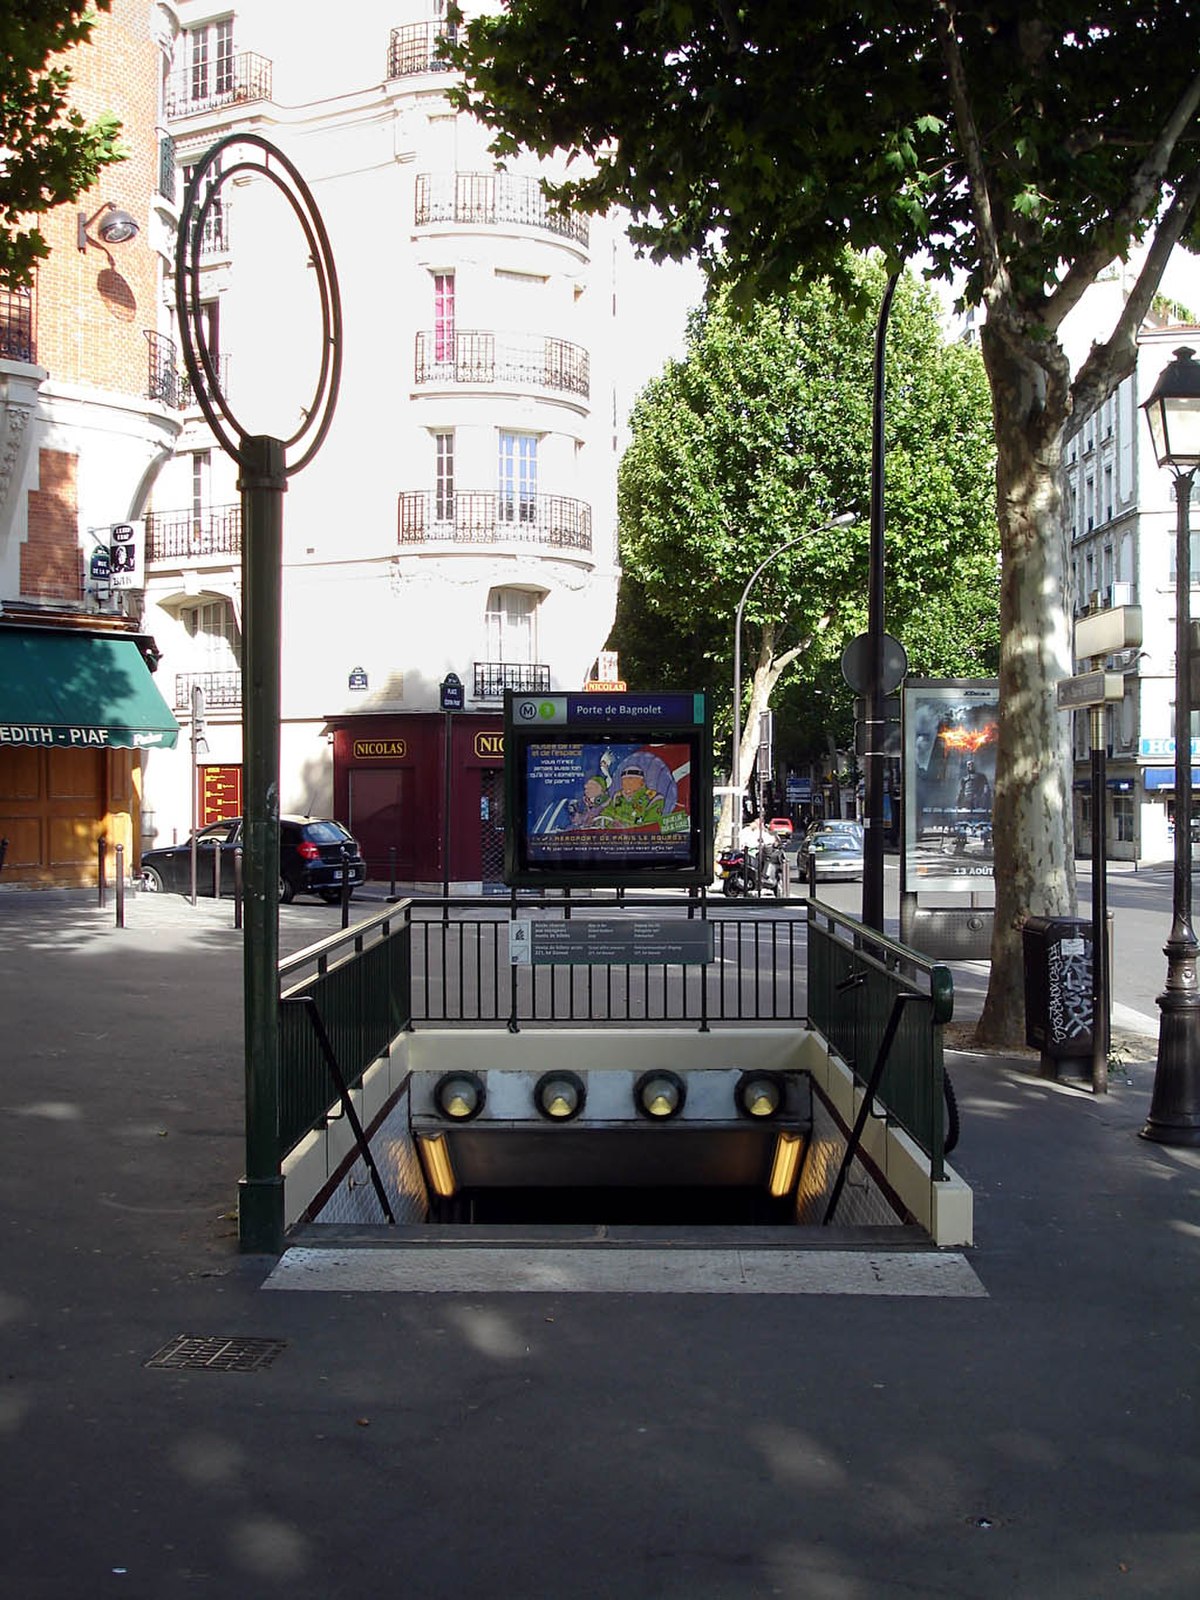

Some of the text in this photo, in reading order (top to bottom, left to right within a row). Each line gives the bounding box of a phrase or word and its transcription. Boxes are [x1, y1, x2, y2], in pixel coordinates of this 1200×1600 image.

[576, 705, 662, 716] Porte de Bagnolet
[0, 727, 54, 743] EDITH
[69, 729, 109, 744] PIAF
[357, 742, 403, 755] NICOLAS
[954, 865, 994, 875] 13 AOÛT
